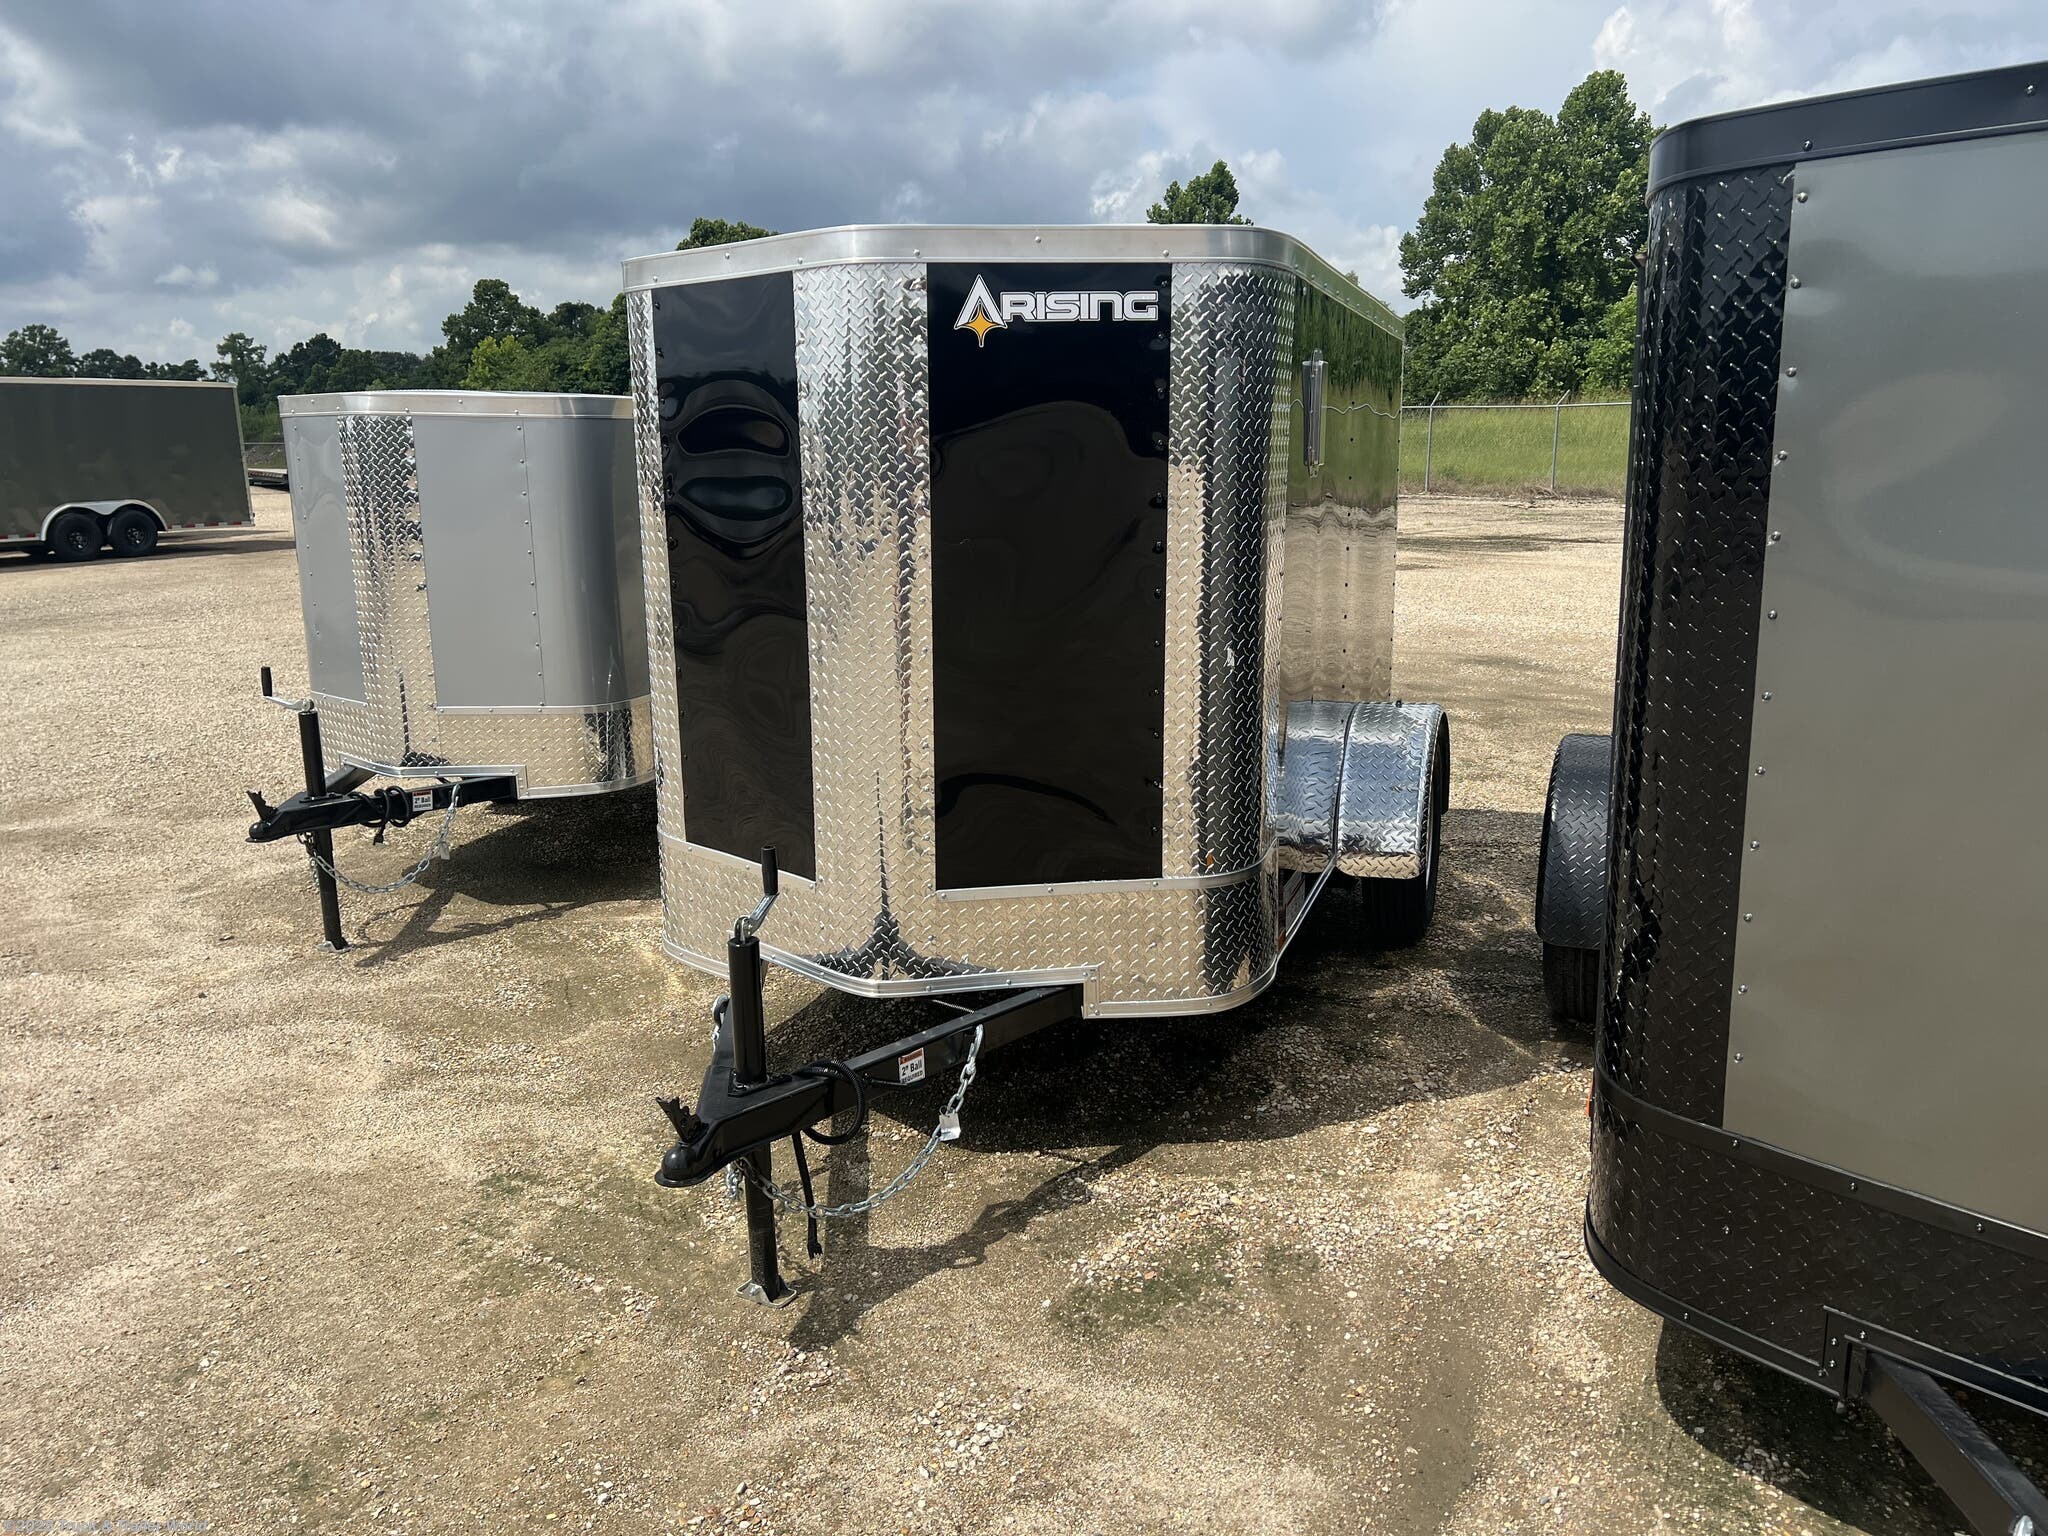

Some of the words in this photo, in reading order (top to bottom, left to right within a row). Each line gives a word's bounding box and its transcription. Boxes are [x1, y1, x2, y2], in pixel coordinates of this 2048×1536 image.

[953, 273, 1159, 331] ARISING
[901, 1065, 909, 1076] 2"
[910, 1059, 923, 1073] Ball
